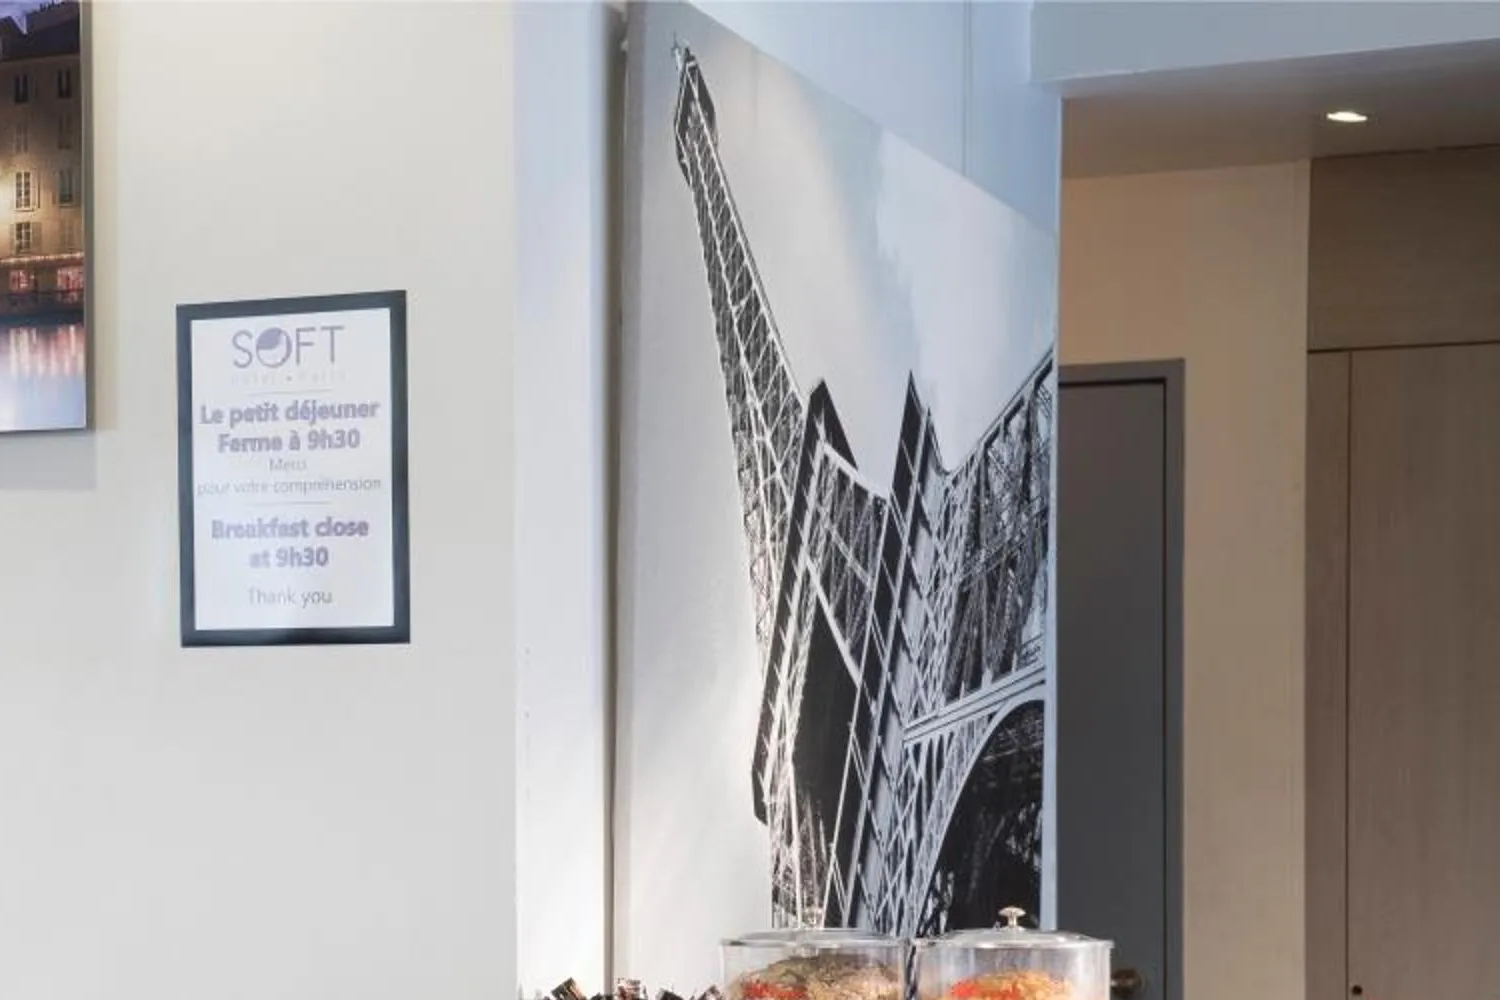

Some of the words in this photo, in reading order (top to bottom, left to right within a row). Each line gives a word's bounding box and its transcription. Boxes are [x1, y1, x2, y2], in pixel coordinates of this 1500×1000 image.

[232, 325, 345, 369] SOFT
[200, 404, 224, 425] Le
[229, 402, 279, 428] petit
[285, 399, 381, 426] déjeuner
[218, 433, 282, 453] Ferme
[289, 430, 301, 450] à
[307, 428, 360, 450] 9h30
[211, 517, 309, 540] Breakfast
[315, 516, 370, 537] close
[275, 545, 329, 568] 9h30
[248, 585, 299, 606] Thank
[300, 589, 333, 609] you
